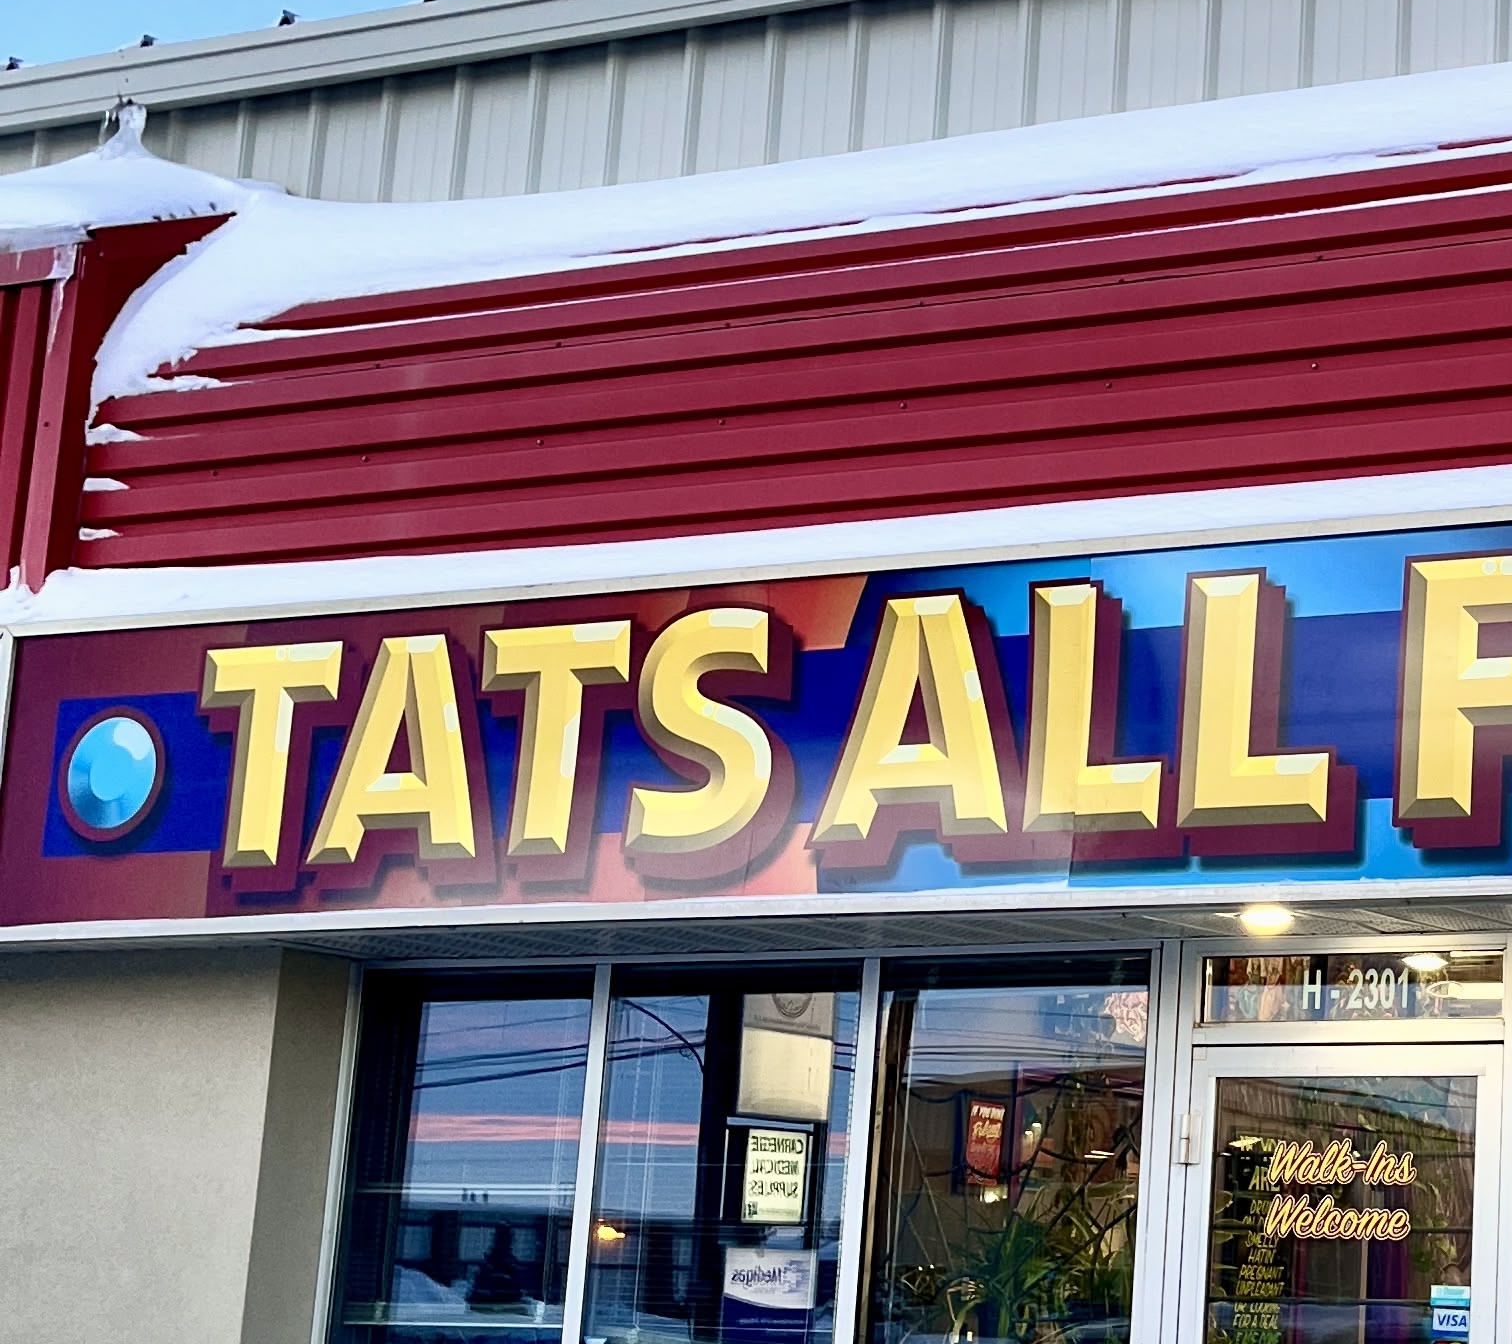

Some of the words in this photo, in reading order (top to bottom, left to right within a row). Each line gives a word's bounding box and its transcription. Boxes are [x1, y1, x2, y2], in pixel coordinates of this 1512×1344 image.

[203, 607, 773, 869] TATS
[809, 573, 1330, 844] ALL
[1302, 969, 1322, 1010] H
[1346, 967, 1410, 1010] 2301
[1267, 1138, 1417, 1185] Walk-Ins
[1264, 1193, 1411, 1240] Welcome
[1437, 1313, 1468, 1328] VISA
